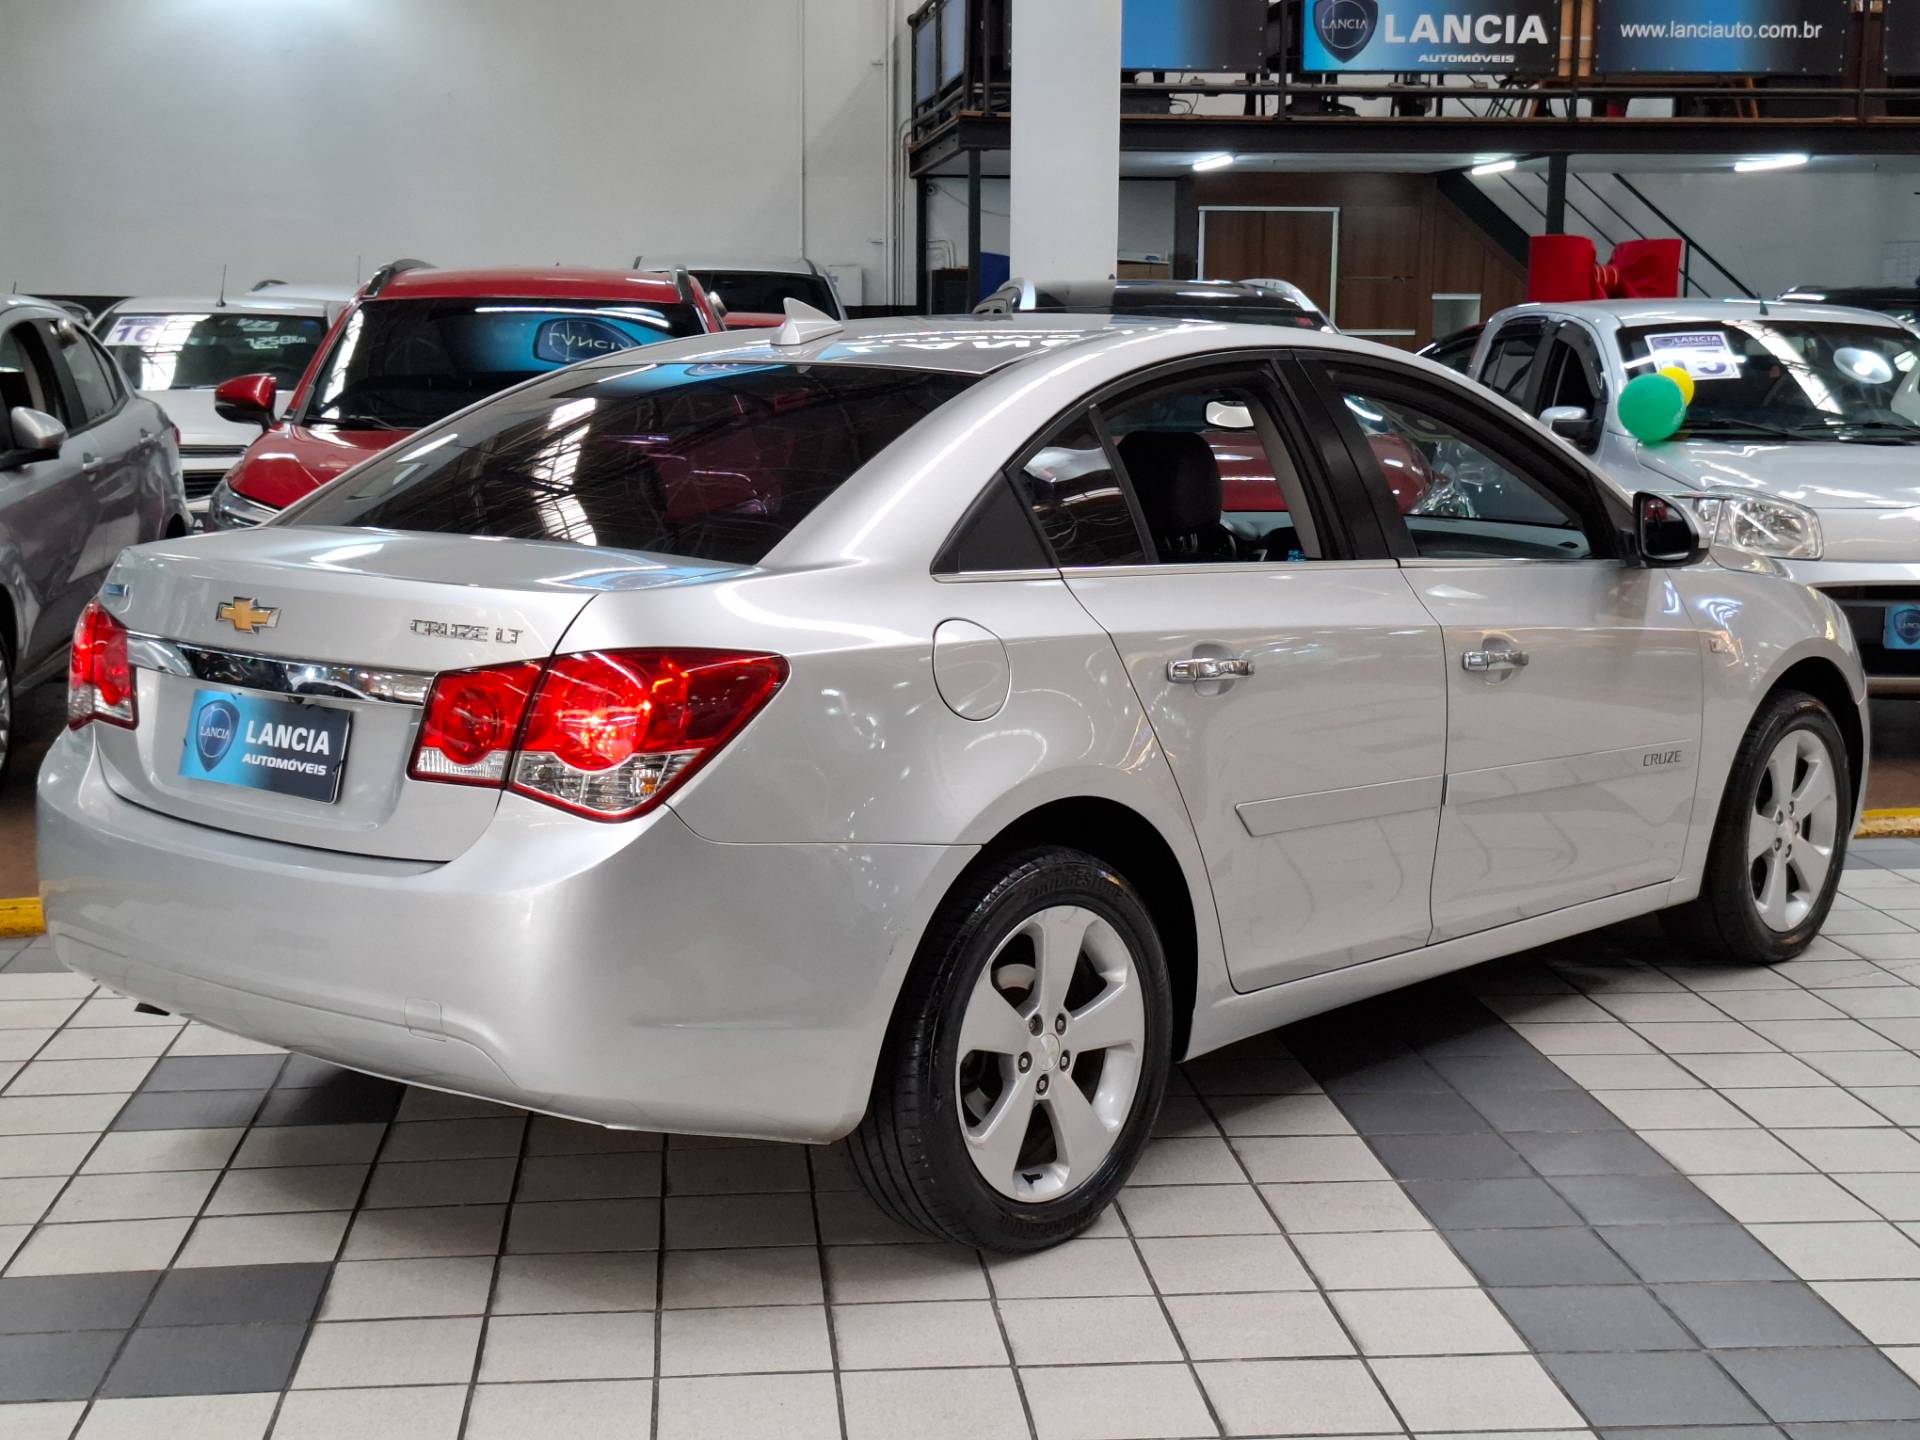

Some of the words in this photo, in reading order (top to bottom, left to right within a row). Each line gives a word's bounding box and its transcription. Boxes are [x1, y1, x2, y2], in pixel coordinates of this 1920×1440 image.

[1321, 18, 1368, 30] LANCIA
[1384, 14, 1549, 45] LANCIA
[1620, 20, 1823, 39] www.lanciauto.com.br
[1418, 53, 1515, 63] AUTOMÓVEIS
[115, 326, 157, 342] 16
[409, 619, 489, 642] CRUZE
[496, 627, 524, 644] LT
[200, 726, 230, 740] LANCIA
[245, 720, 330, 755] LANCIA
[242, 753, 327, 776] AUTOMÓVEIS
[1642, 750, 1682, 767] CRUZE
